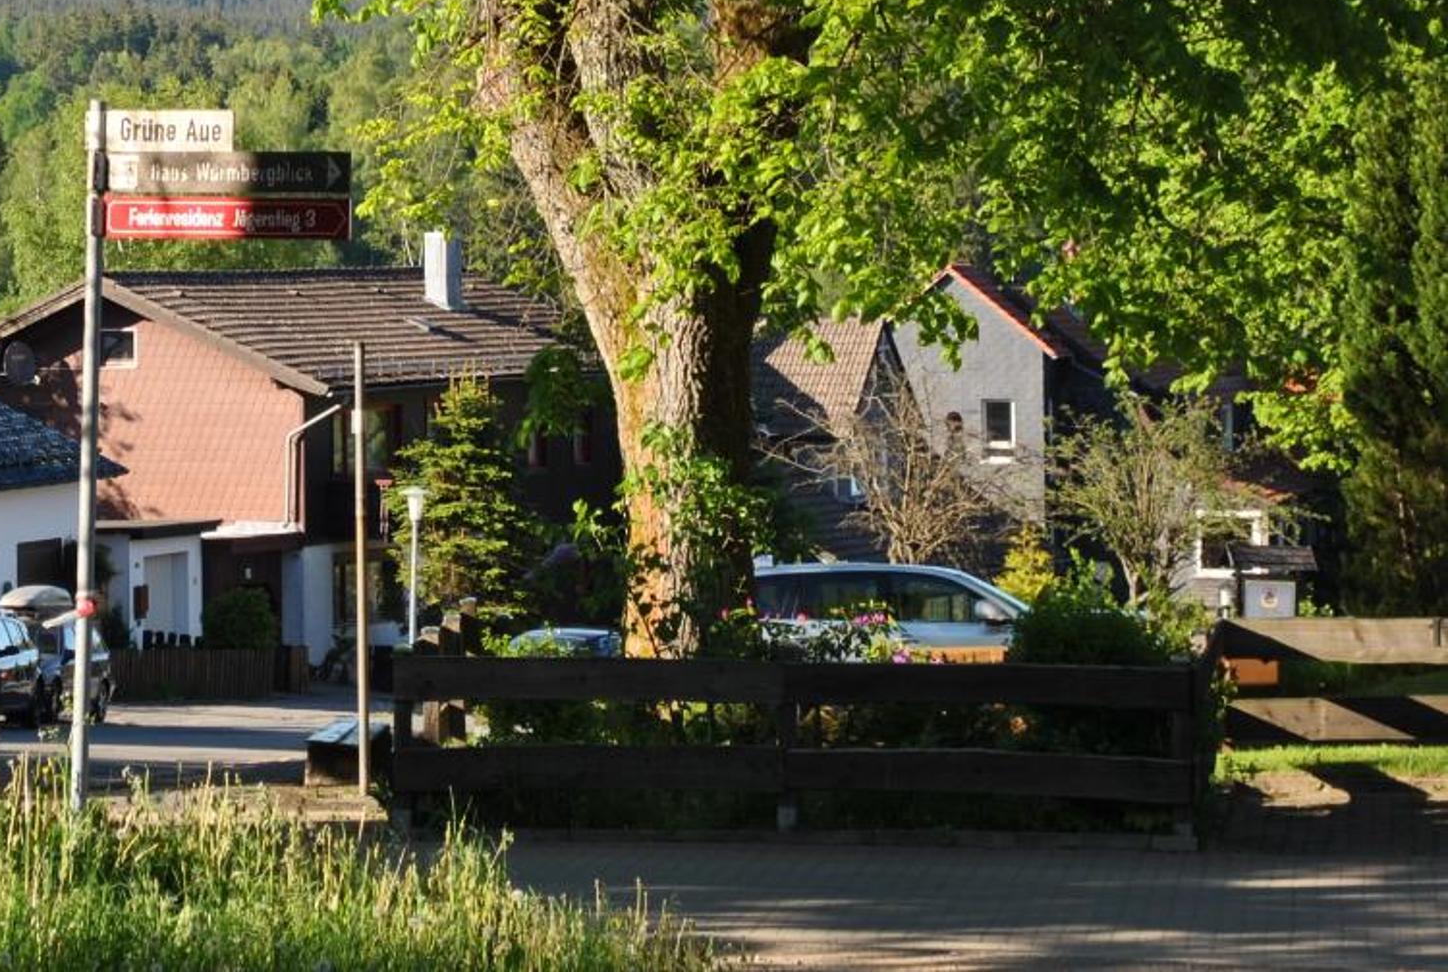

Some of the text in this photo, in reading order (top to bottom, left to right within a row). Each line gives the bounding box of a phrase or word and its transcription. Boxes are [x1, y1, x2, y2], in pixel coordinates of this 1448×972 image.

[120, 117, 222, 142] Grüne Aue
[195, 161, 314, 186] Wurmbergblick
[127, 206, 225, 227] Ferienresidenz
[304, 208, 317, 229] 3
